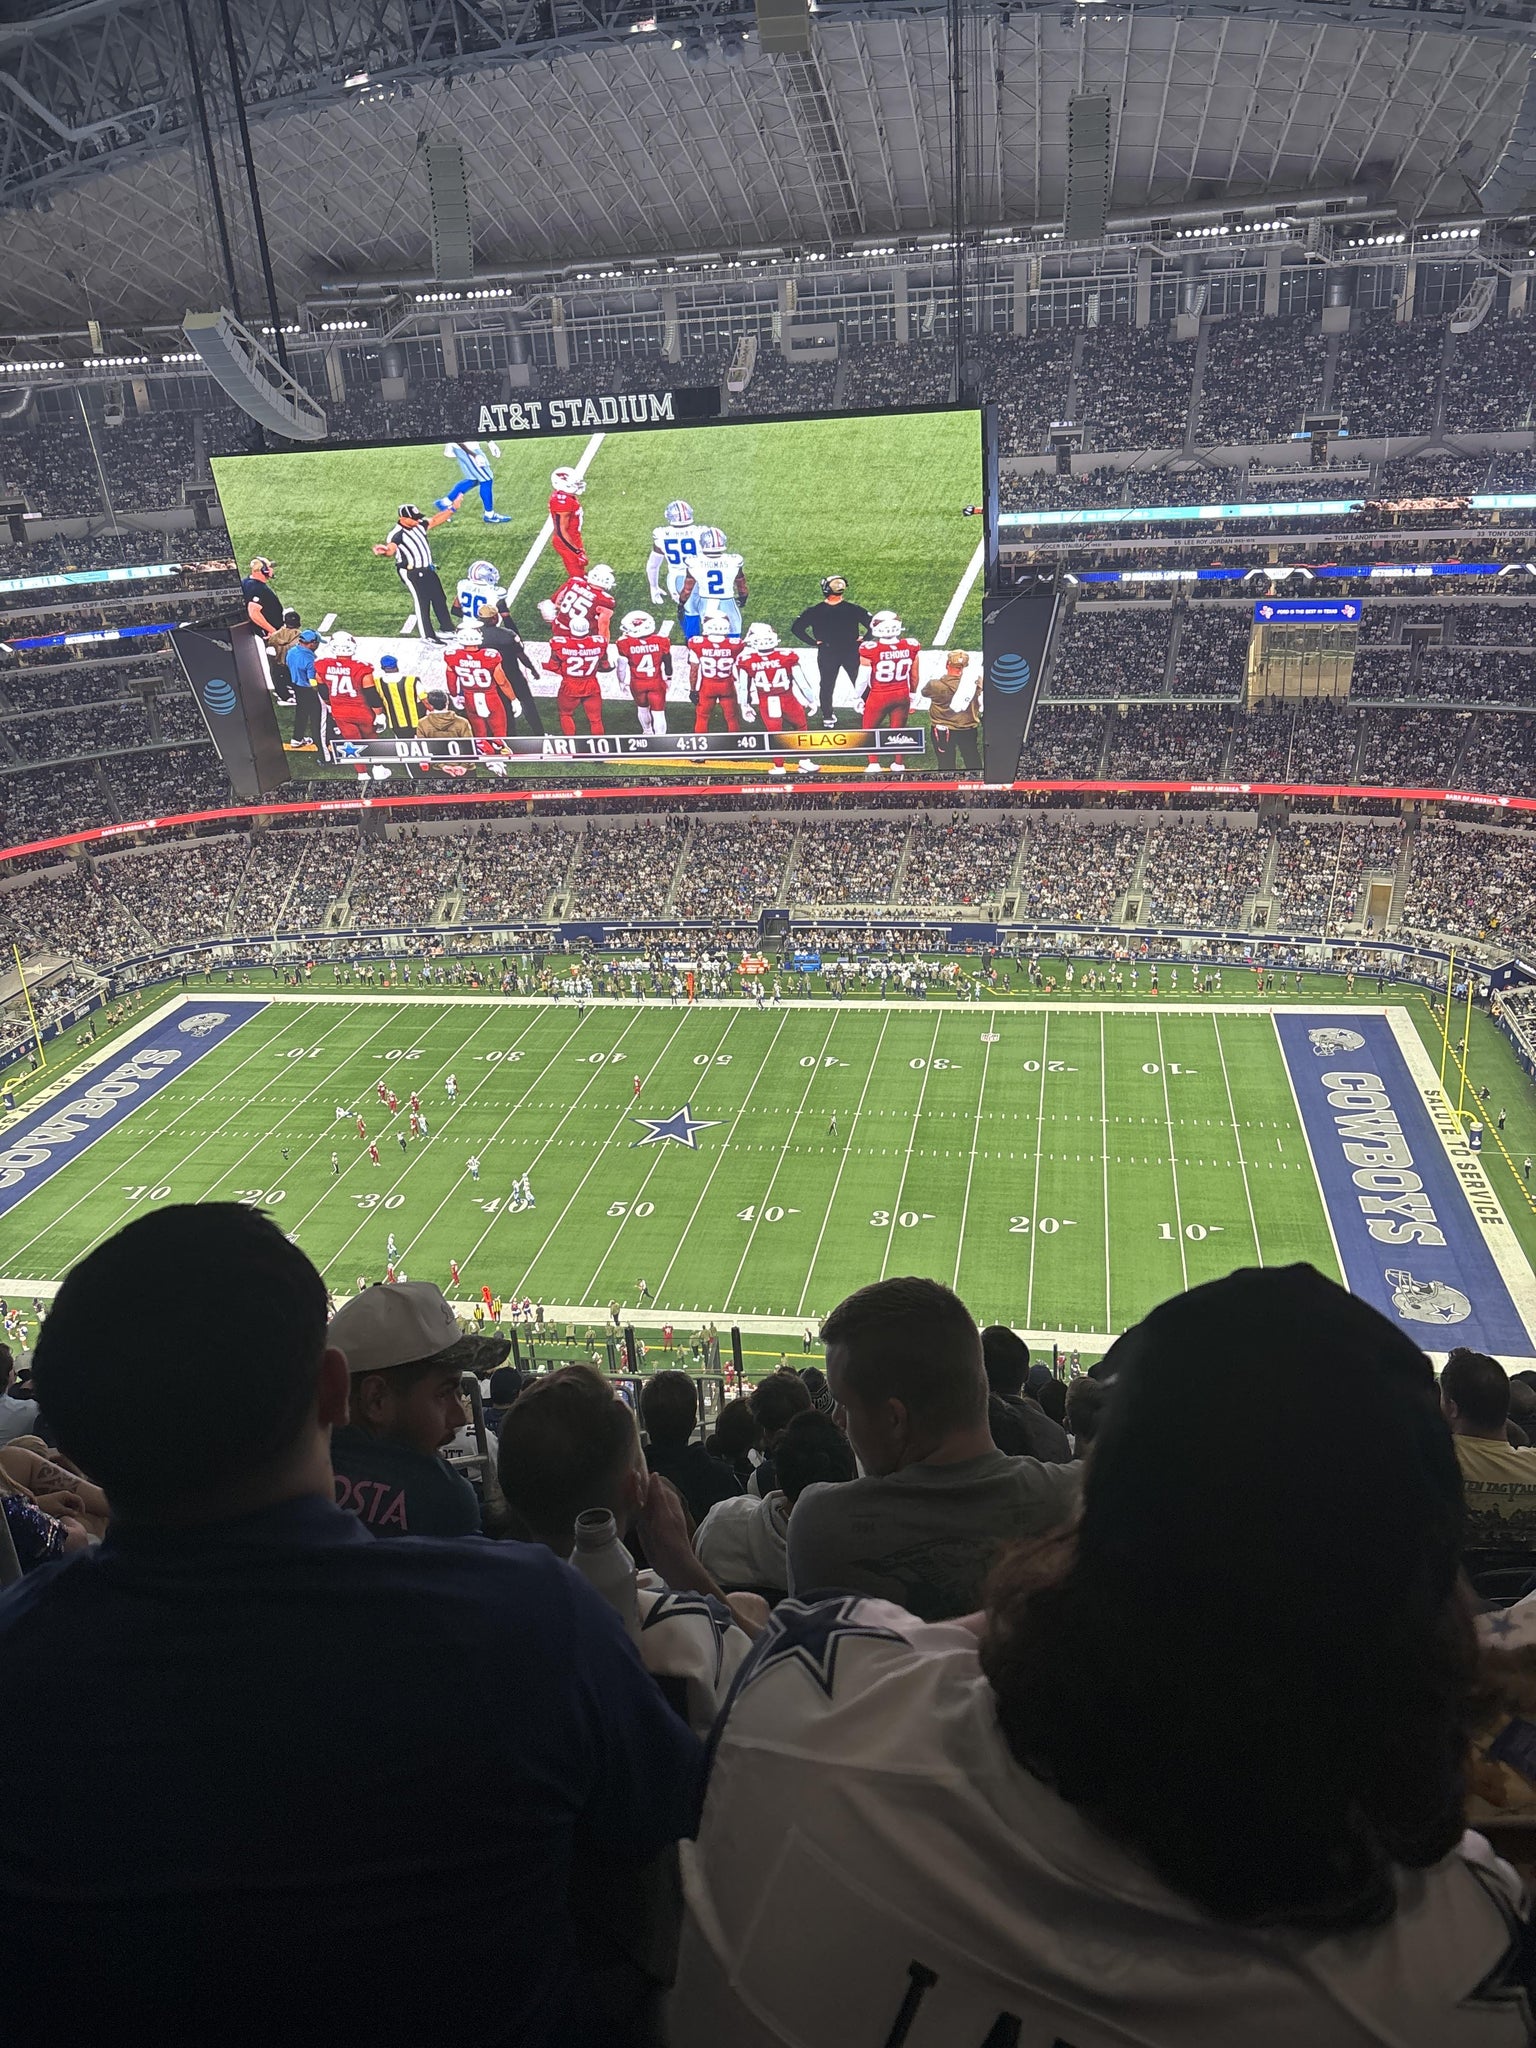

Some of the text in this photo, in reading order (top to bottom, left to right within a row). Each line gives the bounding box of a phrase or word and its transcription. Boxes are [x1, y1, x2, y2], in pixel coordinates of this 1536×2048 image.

[478, 393, 675, 432] AT&T STADIUM
[663, 537, 698, 565] 59
[700, 560, 729, 569] THOMAS
[706, 569, 725, 595] 2
[560, 590, 594, 619] 85
[629, 643, 660, 655] DORTCH
[701, 647, 732, 657] WEAVER
[879, 648, 910, 660] FEHOKO
[326, 666, 351, 675] ADAMS
[458, 659, 482, 669] SIMON
[566, 655, 600, 677] 27
[636, 654, 656, 677] 4
[700, 656, 735, 679] 89
[751, 659, 782, 672] PAPPOE
[875, 658, 913, 683] 80
[324, 674, 357, 698] 74
[454, 665, 492, 688] 50
[754, 667, 791, 692] 44
[395, 732, 848, 758] DAL 0 ARI 10 2ND 4:13 :40 FLAG
[18, 1094, 53, 1113] ALL
[49, 1078, 72, 1091] OF
[71, 1062, 97, 1075] US
[1320, 1071, 1448, 1246] COWBOYS
[1424, 1090, 1504, 1225] SALUTE TO SERVICE
[124, 1185, 173, 1201] 10
[237, 1188, 287, 1204] 20
[355, 1193, 406, 1210] 30
[479, 1197, 530, 1214] 40
[606, 1200, 656, 1218] 50
[735, 1205, 785, 1223] 40
[869, 1210, 919, 1229] 30
[1008, 1215, 1061, 1235] 20
[1157, 1221, 1208, 1240] 10
